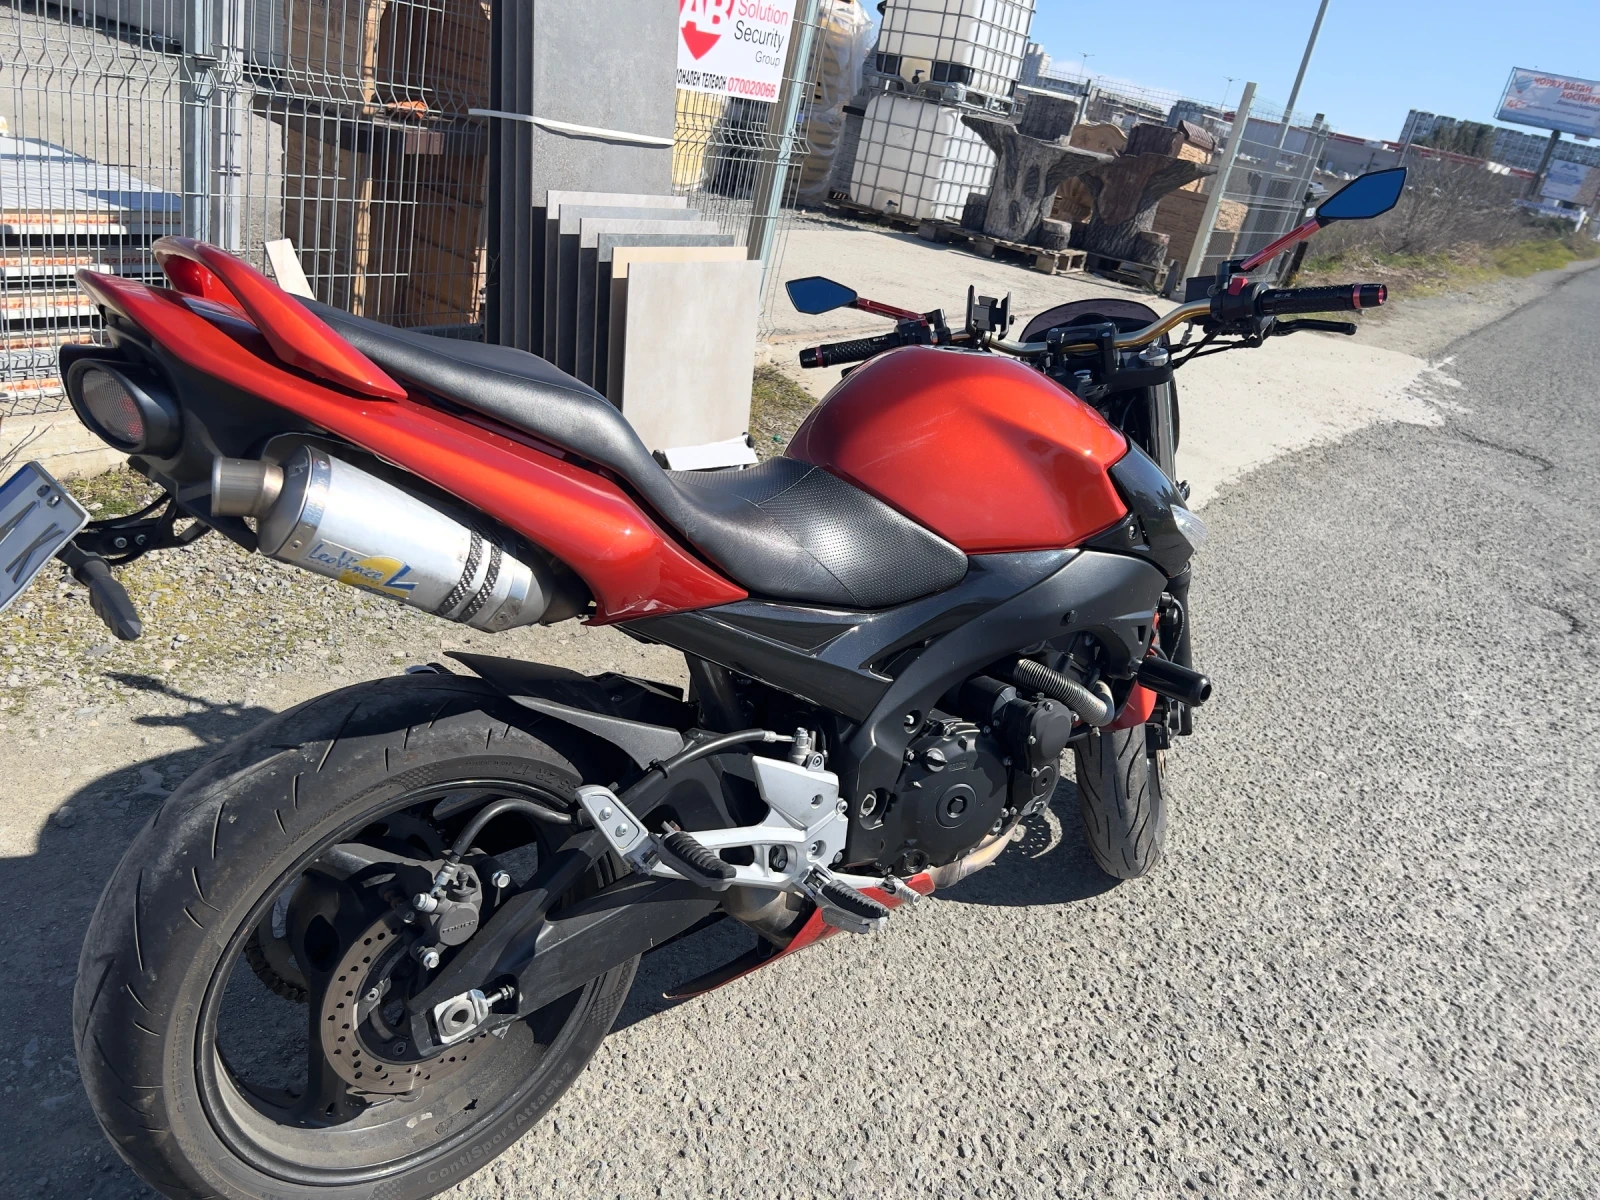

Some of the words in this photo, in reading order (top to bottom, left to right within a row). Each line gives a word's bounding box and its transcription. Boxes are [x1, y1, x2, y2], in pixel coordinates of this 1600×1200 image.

[738, 0, 788, 26] Solution
[734, 20, 784, 53] Security
[755, 50, 781, 68] Group
[677, 69, 702, 88] ОНАЛЕН
[702, 72, 728, 90] ТЕЛЕФОН
[728, 77, 777, 98] 070020066
[308, 543, 385, 580] LeoVince
[426, 1078, 563, 1184] ContiSportAttack
